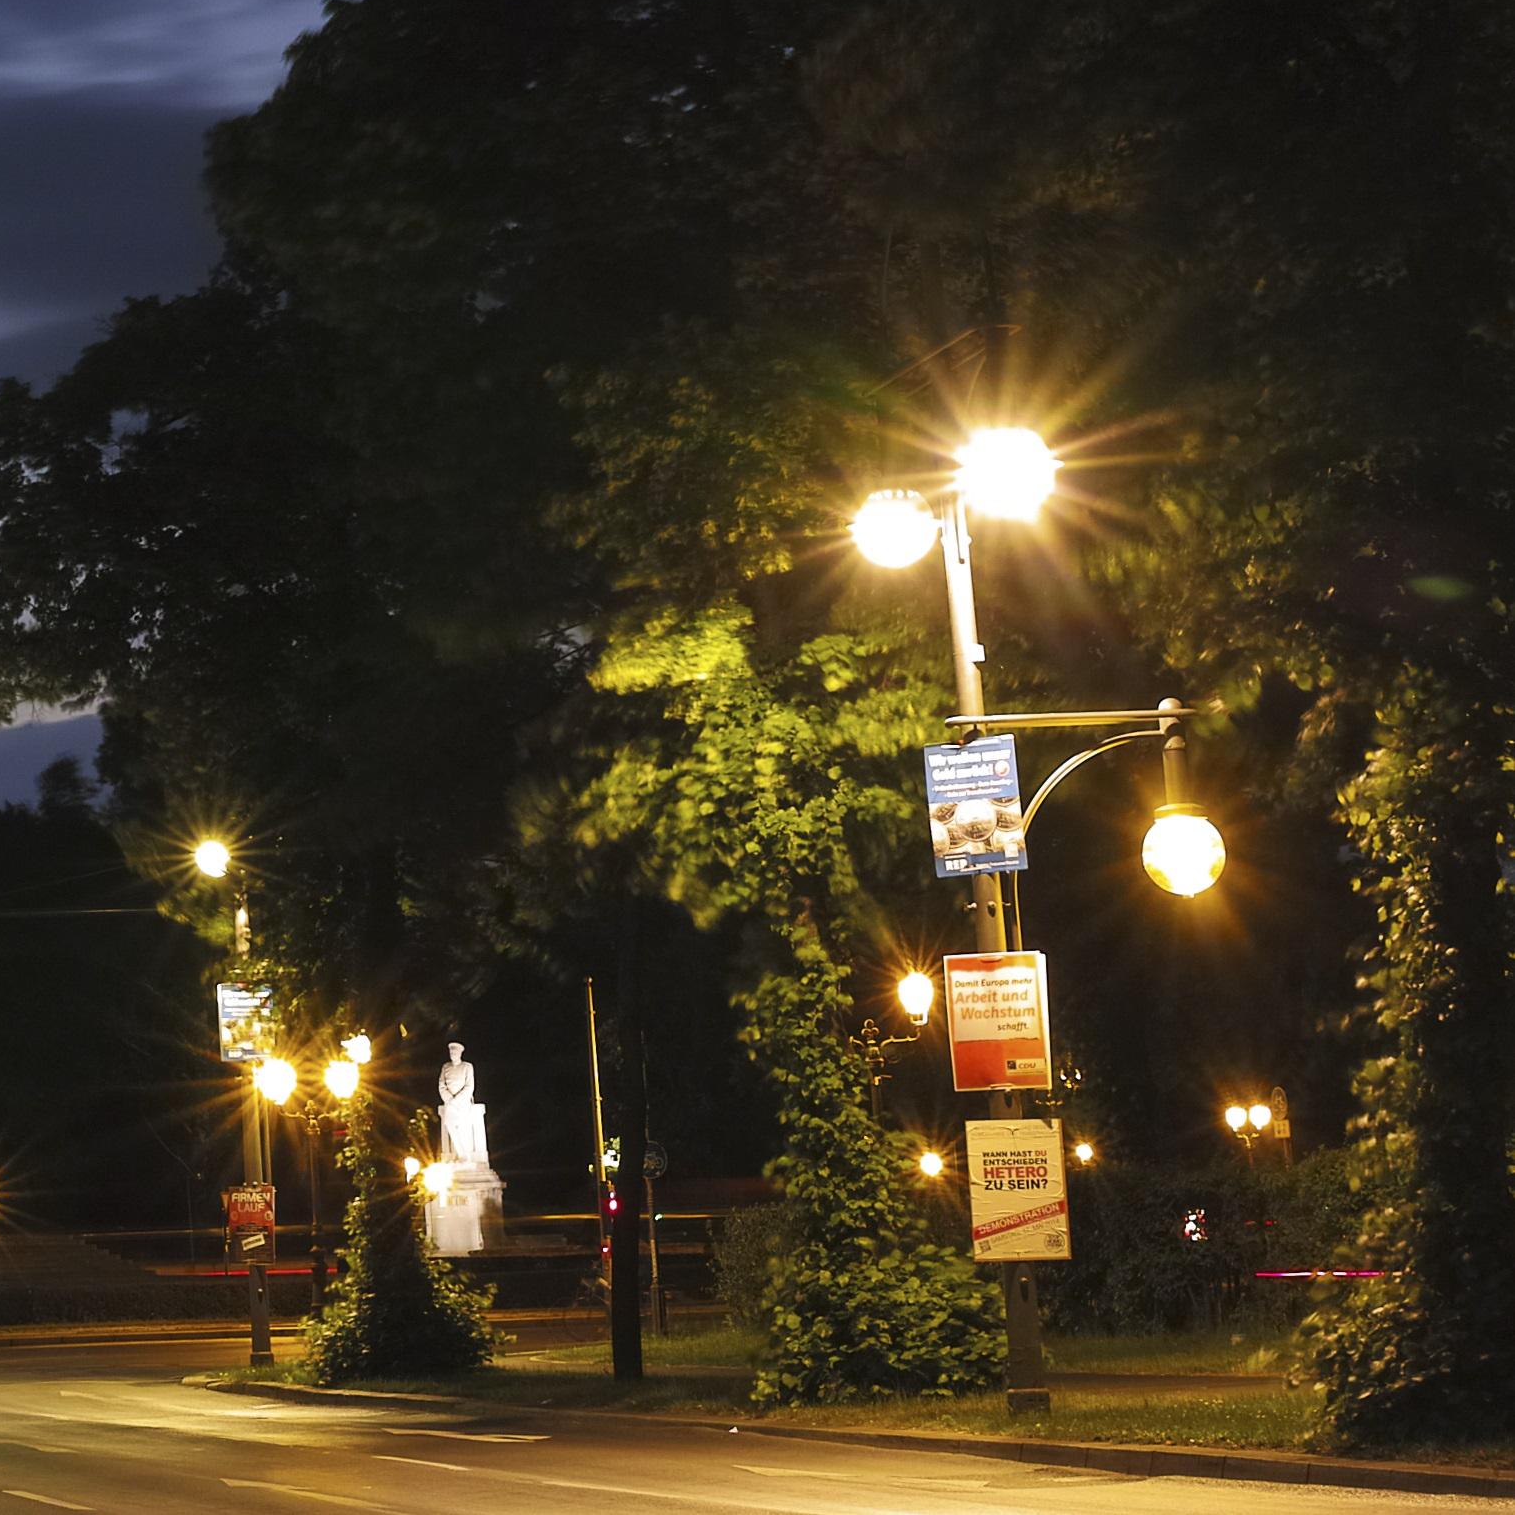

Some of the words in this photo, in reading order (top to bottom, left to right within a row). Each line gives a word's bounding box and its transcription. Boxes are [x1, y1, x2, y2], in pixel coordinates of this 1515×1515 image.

[945, 858, 968, 871] REP
[954, 980, 979, 988] Damit
[981, 979, 1009, 987] Europa
[1012, 978, 1033, 986] mehr
[955, 991, 998, 1004] Arbeit
[1002, 990, 1028, 1001] und
[961, 1006, 1035, 1020] Wachstum
[997, 1022, 1030, 1031] schafft.
[1018, 1062, 1036, 1070] CDU
[983, 1158, 1047, 1166] ENTSCHIEDEN
[983, 1166, 1048, 1179] HETERO
[984, 1180, 1003, 1190] ZU
[1008, 1179, 1048, 1190] SEIN?
[231, 1193, 270, 1202] FIRMEN
[238, 1203, 266, 1212] LAUF
[978, 1202, 1061, 1235] DEMONSTRATION
